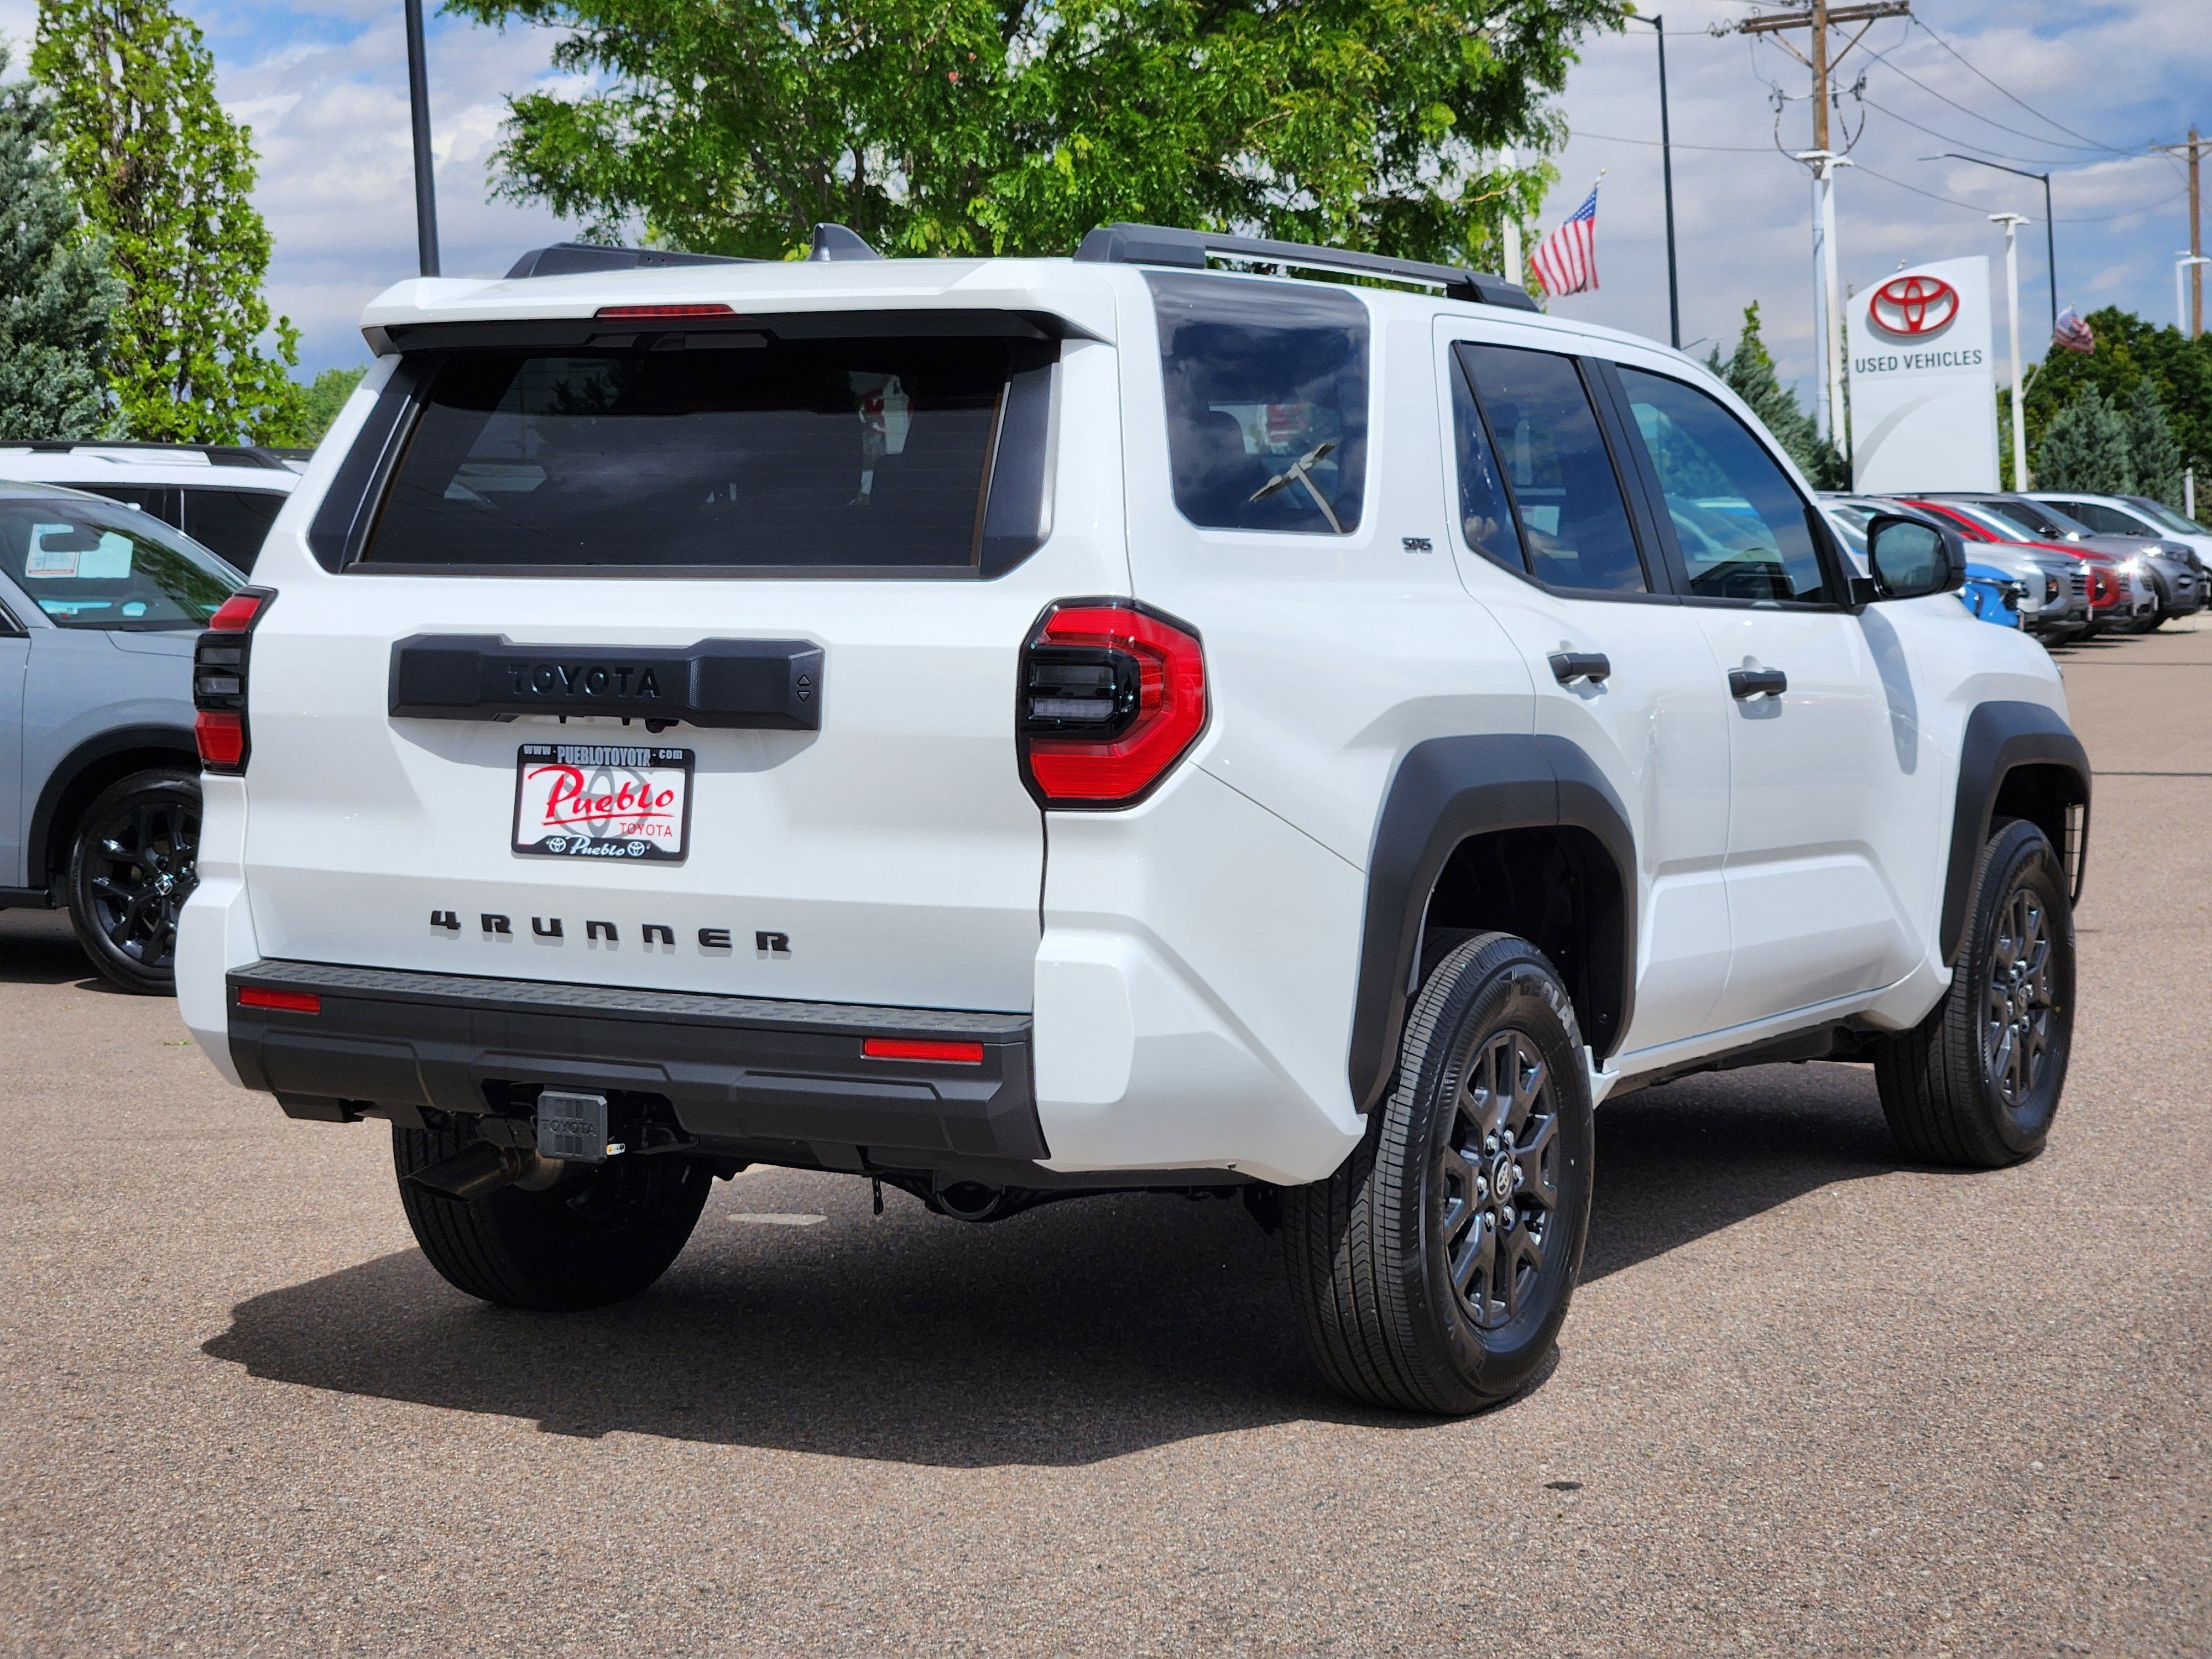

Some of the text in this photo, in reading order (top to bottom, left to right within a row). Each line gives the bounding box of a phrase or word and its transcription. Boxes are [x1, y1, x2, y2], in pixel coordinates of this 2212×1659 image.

[1856, 349, 1983, 373] USED VEHICLES
[507, 664, 661, 698] TOYOTA
[528, 764, 674, 818] Pueblo
[619, 822, 673, 837] TOYOTA
[565, 834, 625, 855] Pueblo
[430, 910, 792, 952] 4RUNNER
[541, 1118, 597, 1137] TOYOTA
